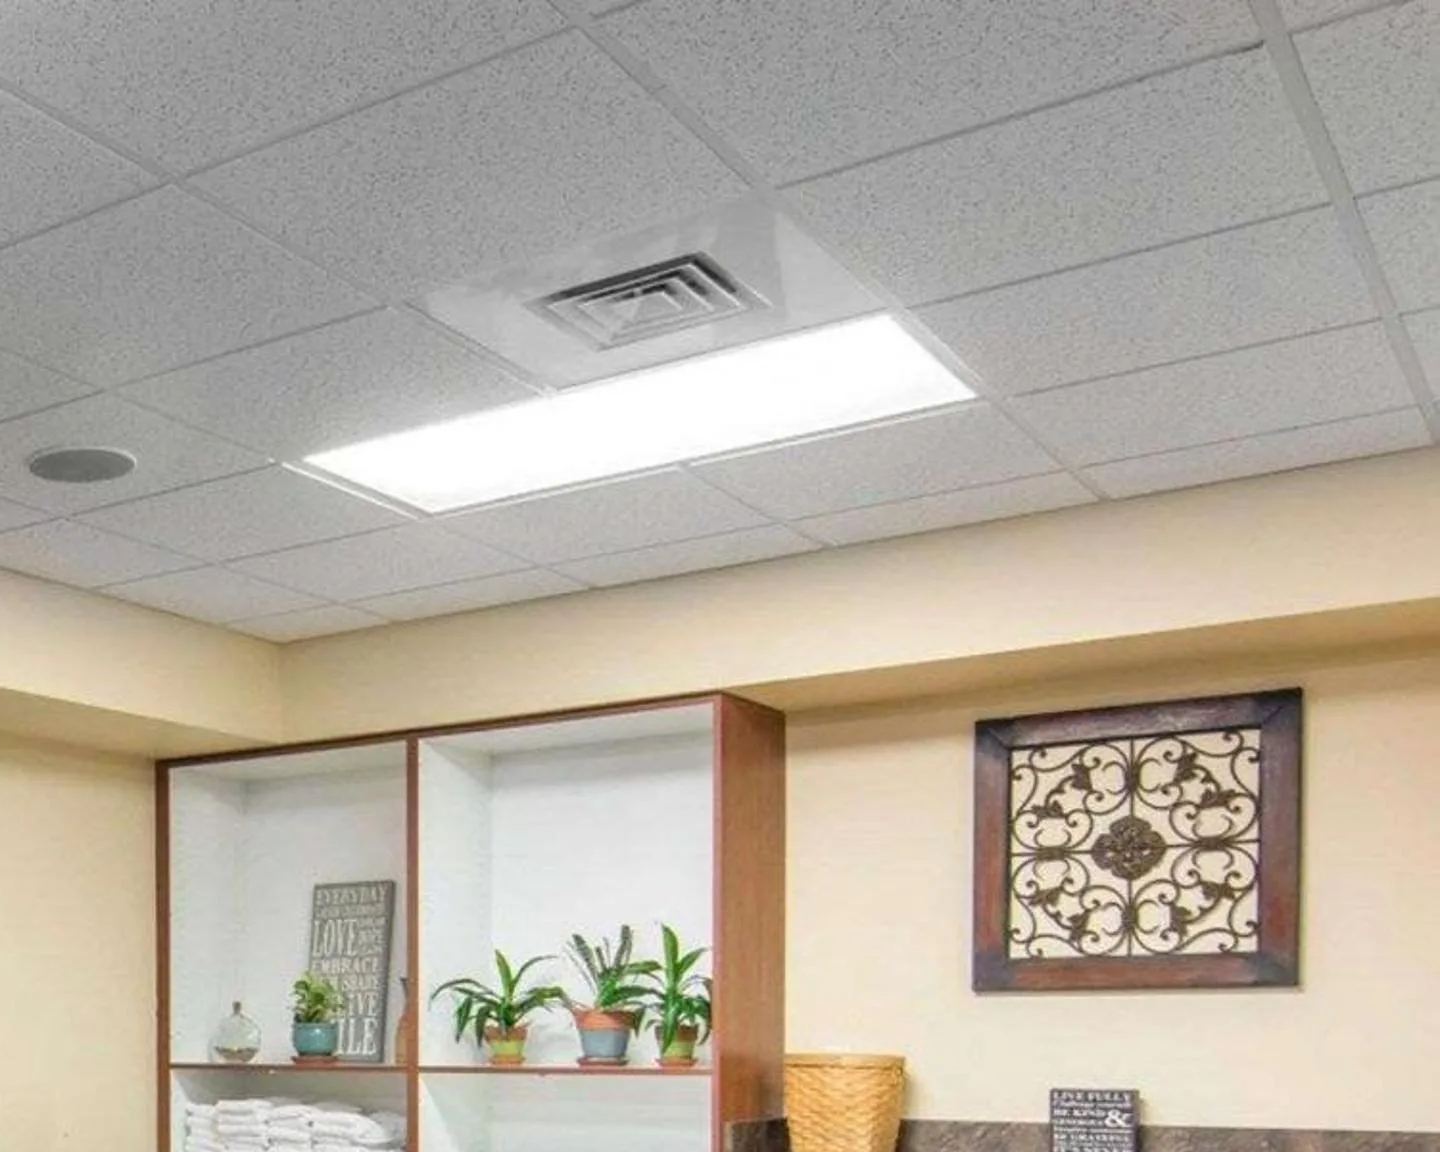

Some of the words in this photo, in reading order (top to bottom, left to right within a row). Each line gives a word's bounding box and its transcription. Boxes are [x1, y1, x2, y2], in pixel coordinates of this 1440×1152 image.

[312, 918, 358, 957] LOVE
[311, 957, 379, 975] EMBRACE
[1104, 1109, 1134, 1128] &
